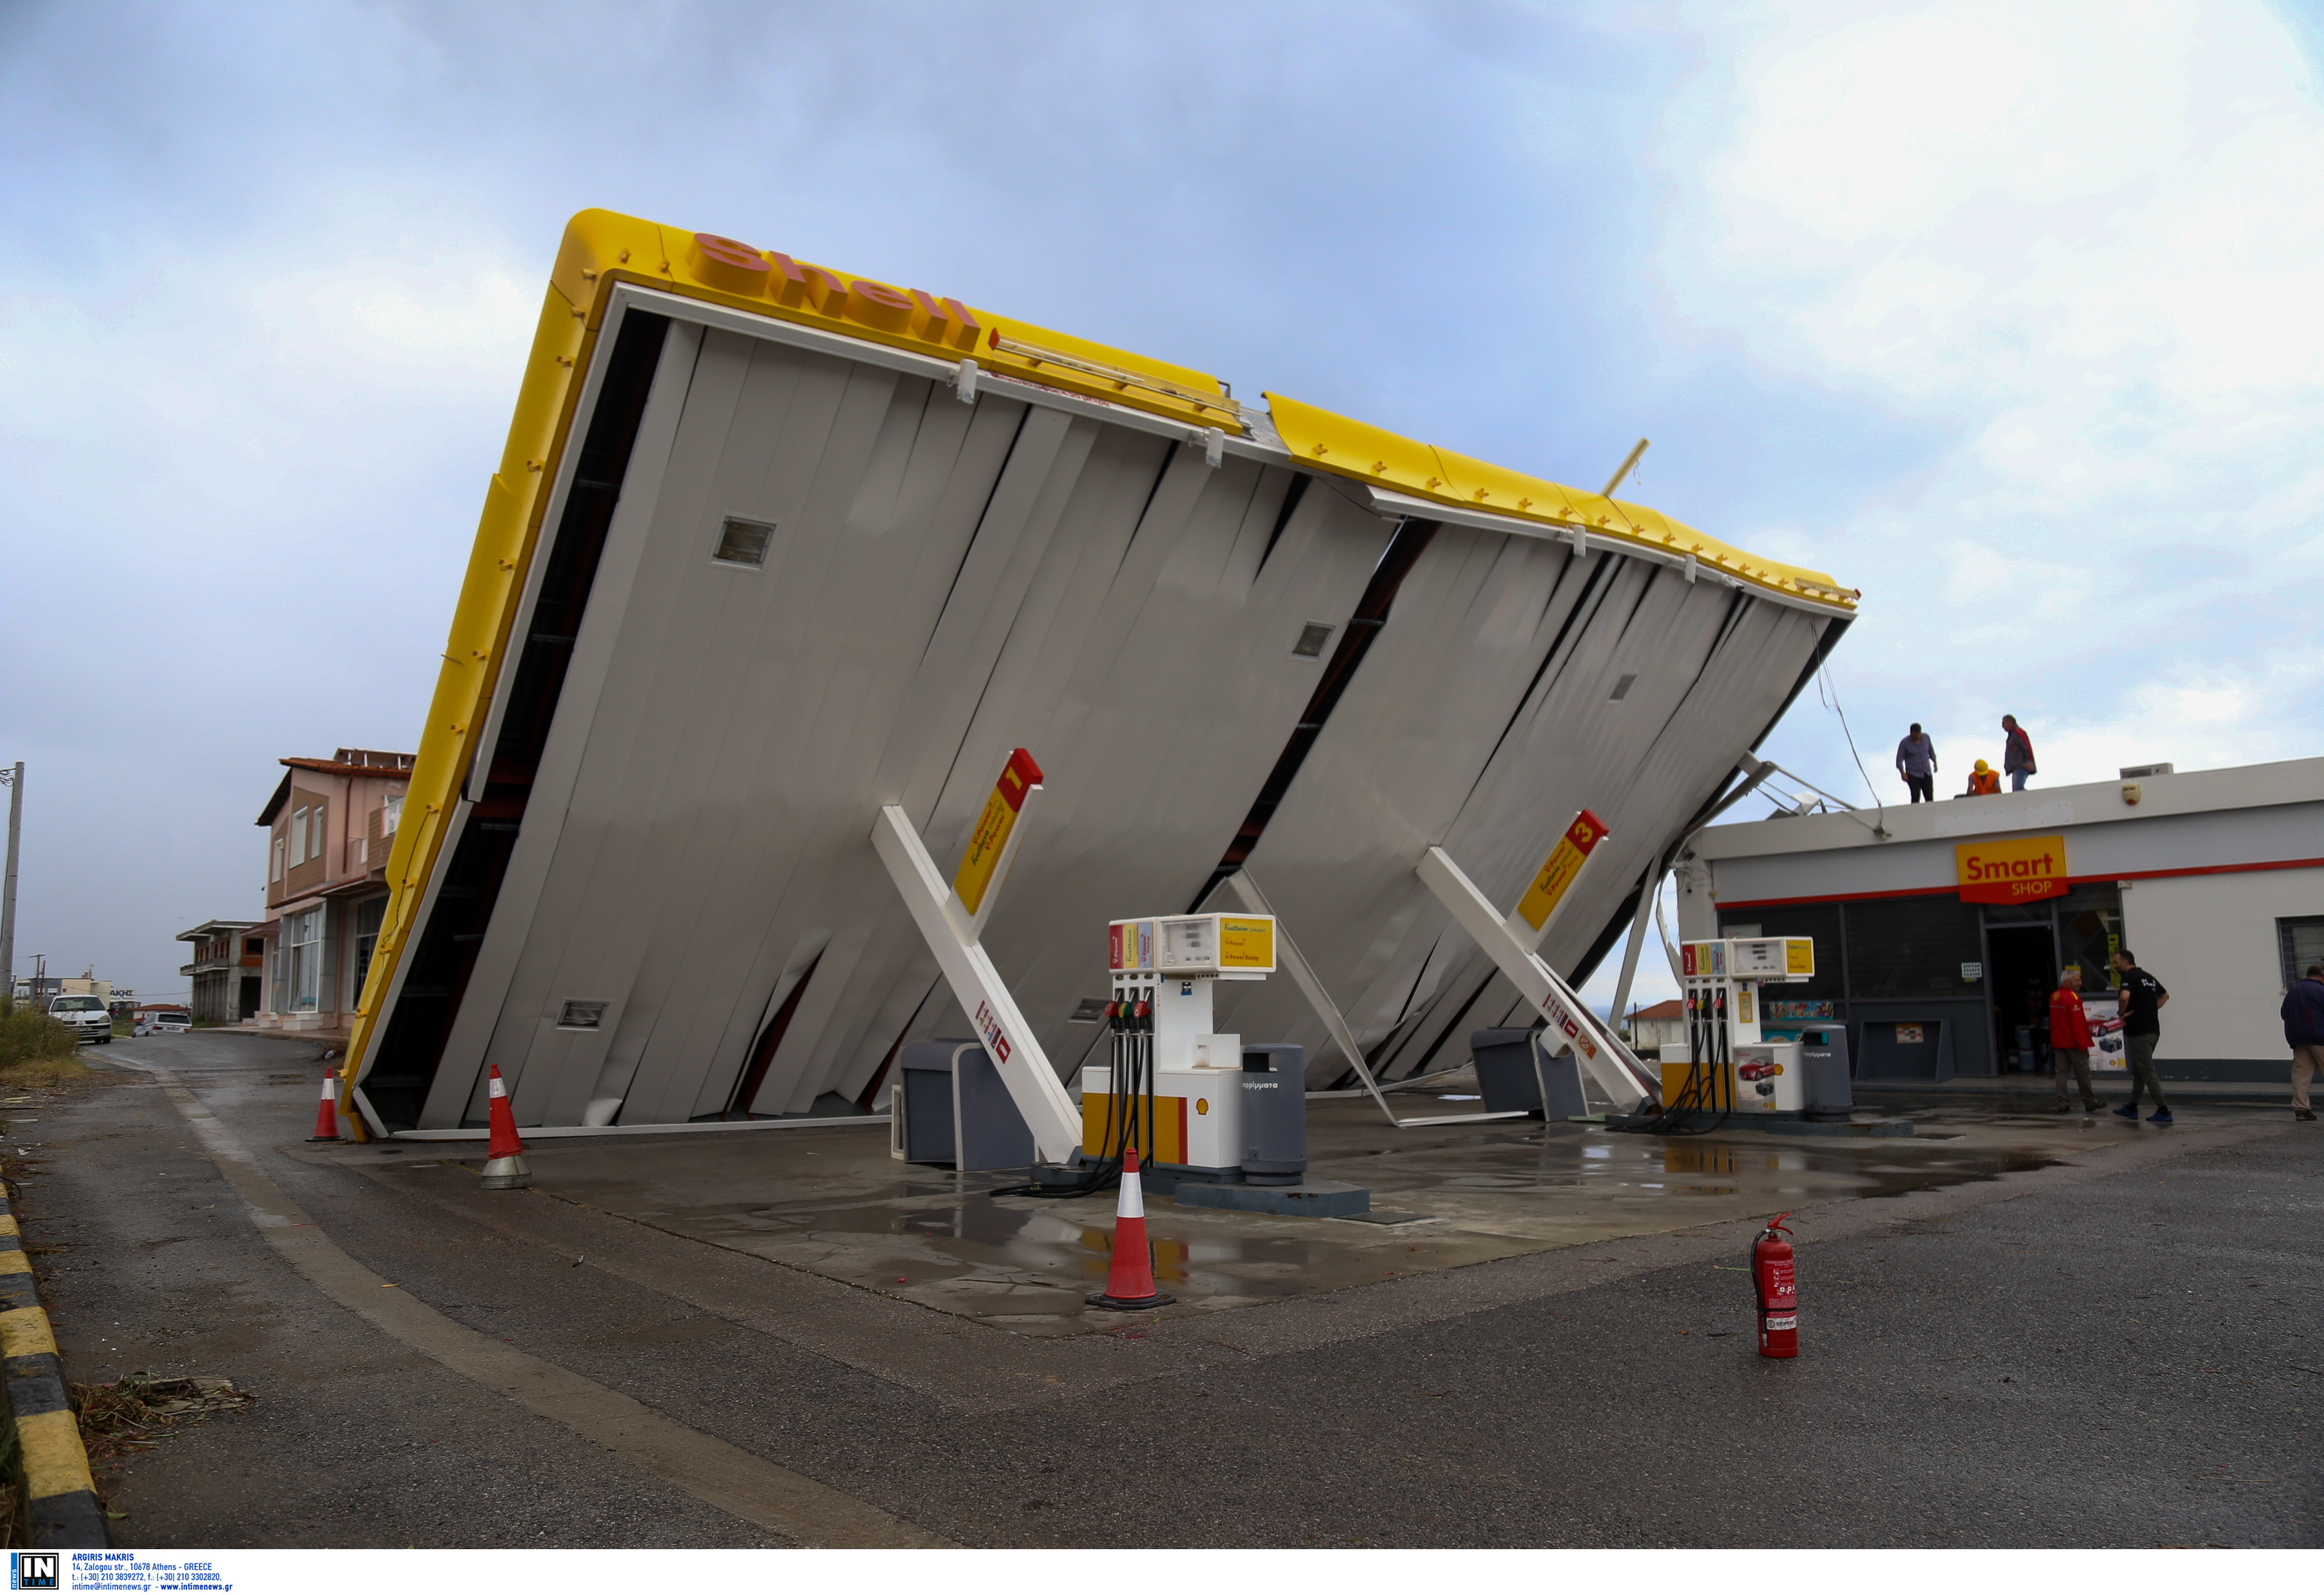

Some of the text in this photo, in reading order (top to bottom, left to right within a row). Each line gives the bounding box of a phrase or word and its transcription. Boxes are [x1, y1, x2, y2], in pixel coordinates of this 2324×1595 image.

[689, 232, 981, 345] Shell
[1006, 766, 1023, 790] 1
[1575, 822, 1593, 843] 3
[1967, 853, 2054, 881] Smart
[2012, 880, 2052, 895] SHOP
